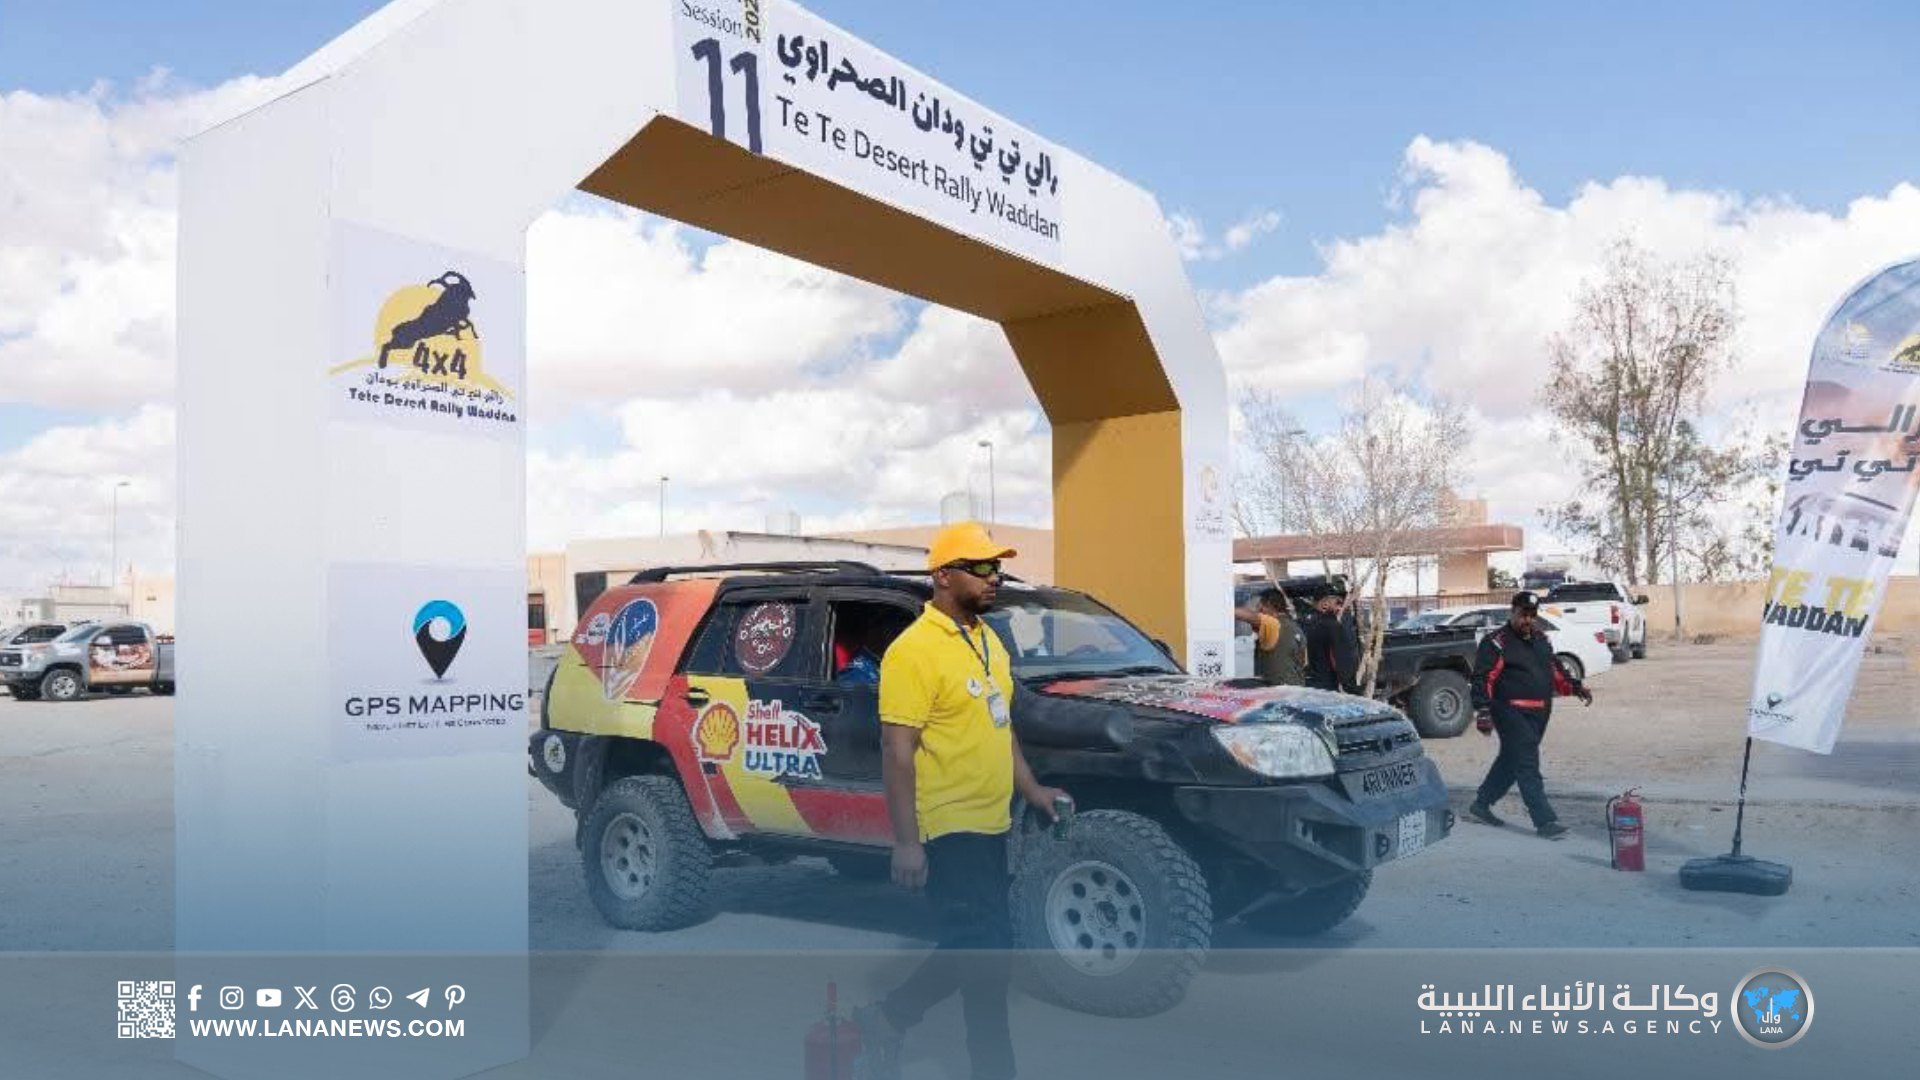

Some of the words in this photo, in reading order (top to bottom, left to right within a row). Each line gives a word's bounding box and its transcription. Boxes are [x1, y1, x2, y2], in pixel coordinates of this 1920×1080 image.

[777, 33, 906, 111] الصحراوي
[690, 37, 763, 154] 11
[912, 92, 965, 151] ودان
[970, 126, 993, 172] تي
[998, 139, 1021, 185] تي
[776, 95, 809, 136] Te
[816, 112, 847, 151] Te
[855, 130, 929, 186] Desert
[935, 164, 982, 213] Rally
[987, 187, 1060, 242] Waddan
[1025, 152, 1058, 197] رالي
[413, 342, 467, 380] 4x4
[384, 393, 427, 410] Desert
[1788, 450, 1851, 482] تي
[1763, 600, 1869, 638] ADDAN
[345, 697, 402, 717] GPS
[408, 693, 525, 715] MAPPING
[747, 702, 781, 720] Shell
[747, 723, 823, 750] HELIX
[746, 750, 820, 776] ULTRA
[1363, 762, 1417, 796] 4RUNNER
